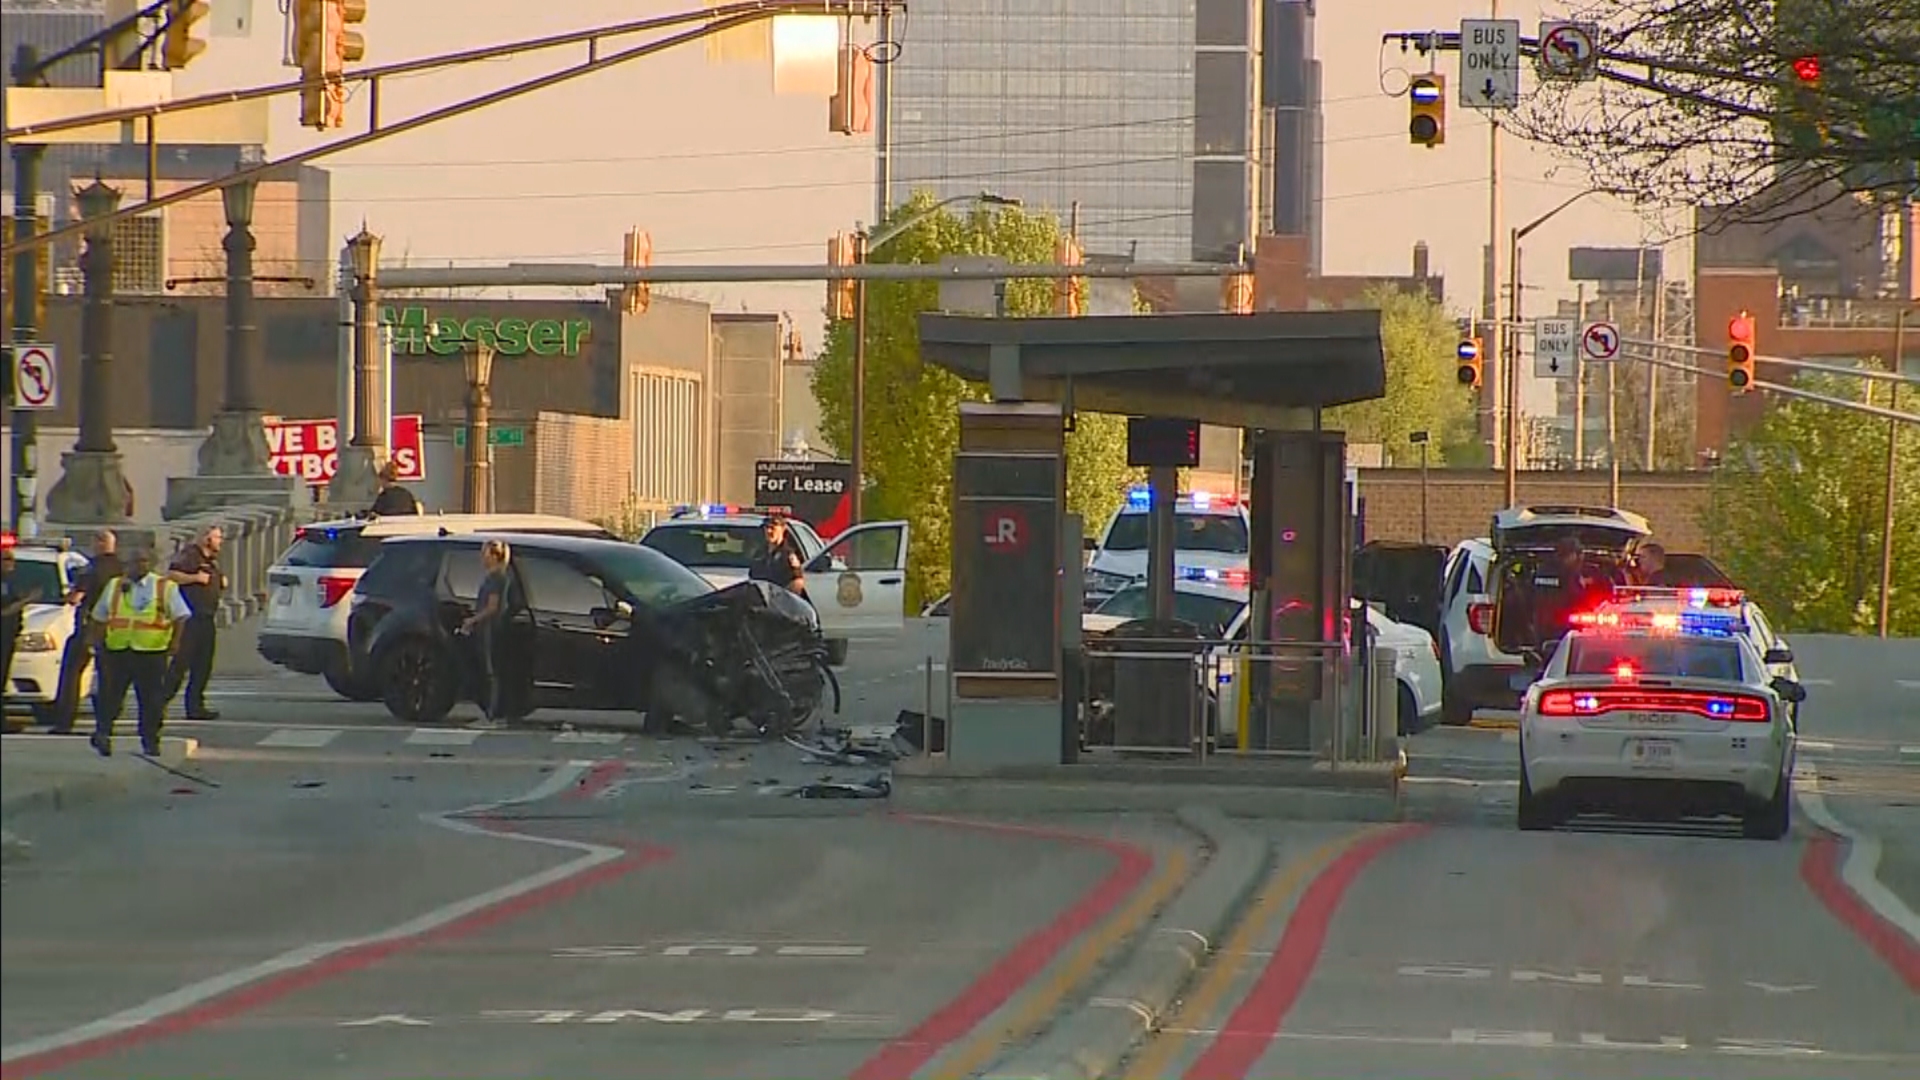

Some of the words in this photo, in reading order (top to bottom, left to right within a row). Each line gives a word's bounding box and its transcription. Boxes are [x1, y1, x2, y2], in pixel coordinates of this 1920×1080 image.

[1473, 29, 1506, 45] BUS
[1467, 52, 1510, 69] ONLY
[380, 304, 591, 355] Messer
[1543, 323, 1567, 335] BUS
[1539, 339, 1569, 352] ONLY
[757, 475, 787, 491] For
[794, 475, 844, 493] Lease
